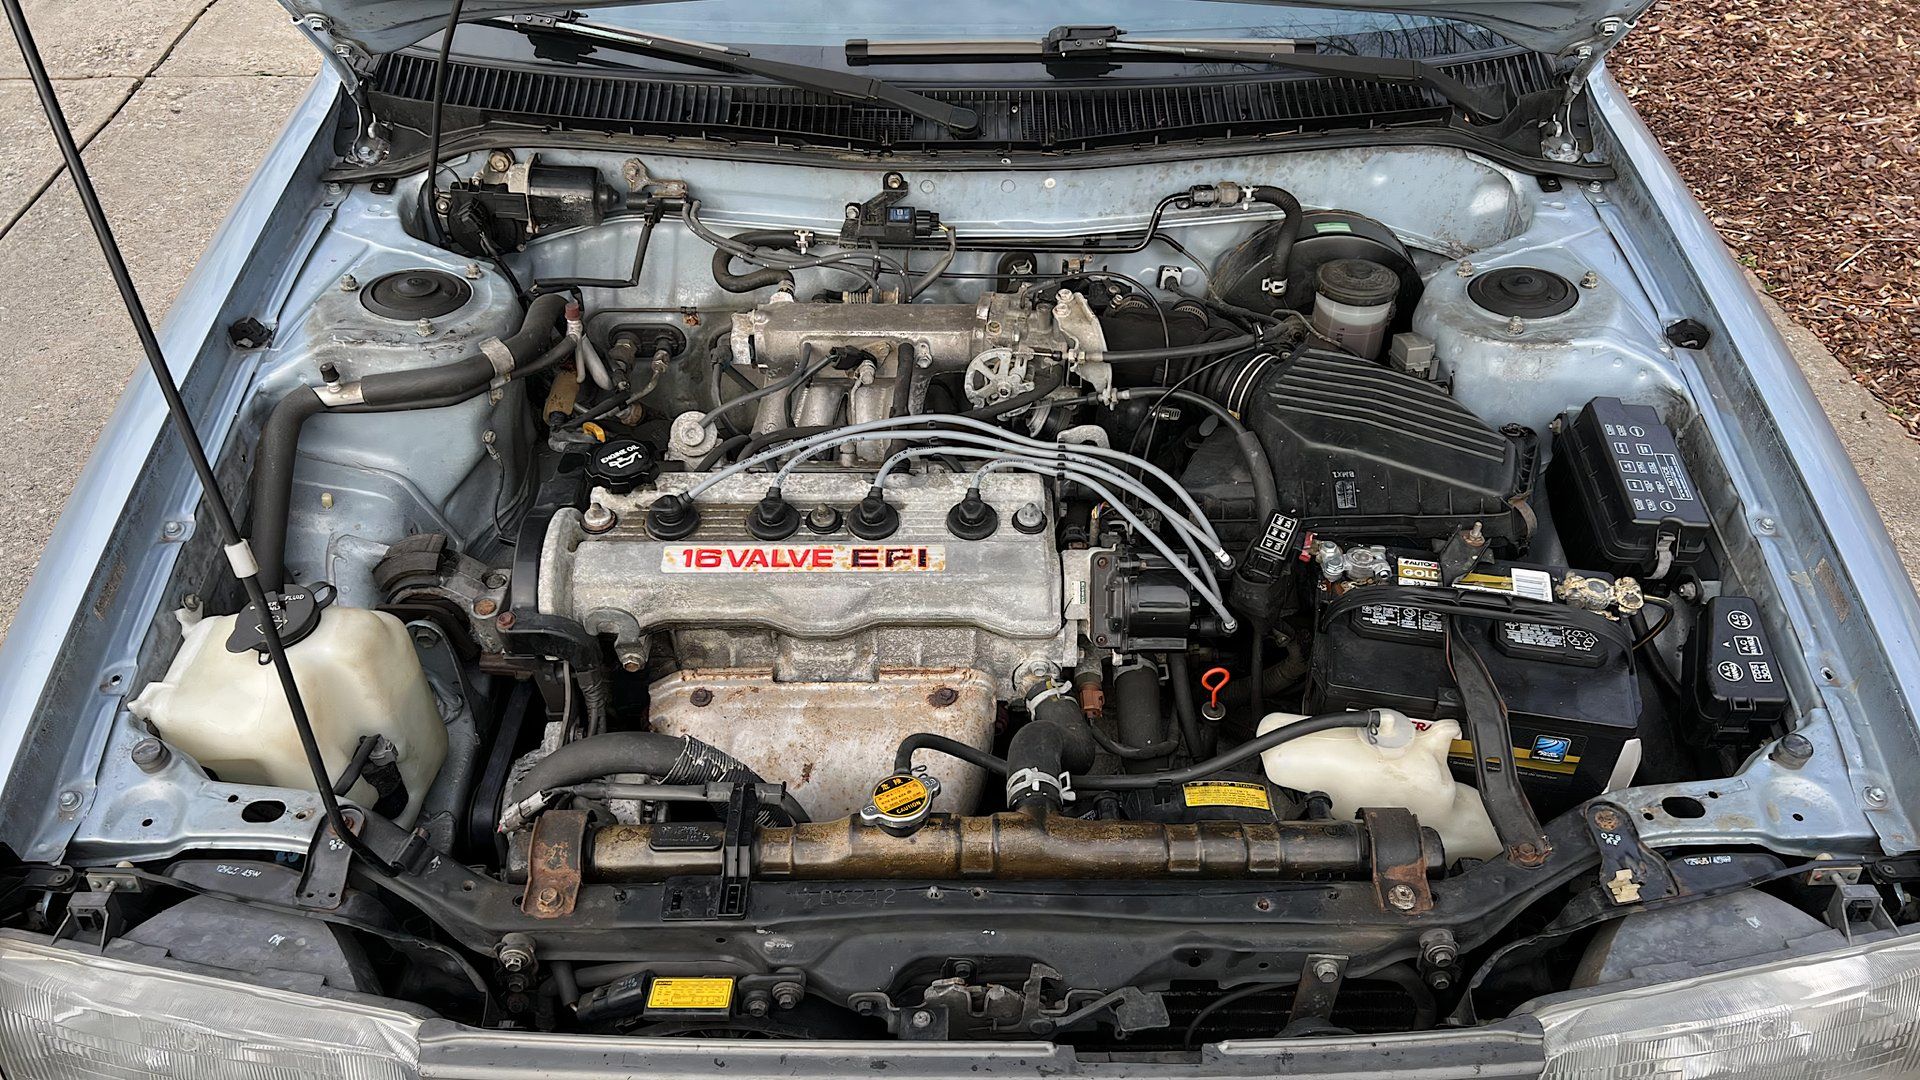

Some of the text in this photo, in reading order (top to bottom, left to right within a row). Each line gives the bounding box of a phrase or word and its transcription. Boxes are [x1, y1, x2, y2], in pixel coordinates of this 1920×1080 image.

[600, 444, 640, 464] ENGINE OIL
[850, 548, 931, 568] EFI
[896, 800, 922, 814] CAUTION
